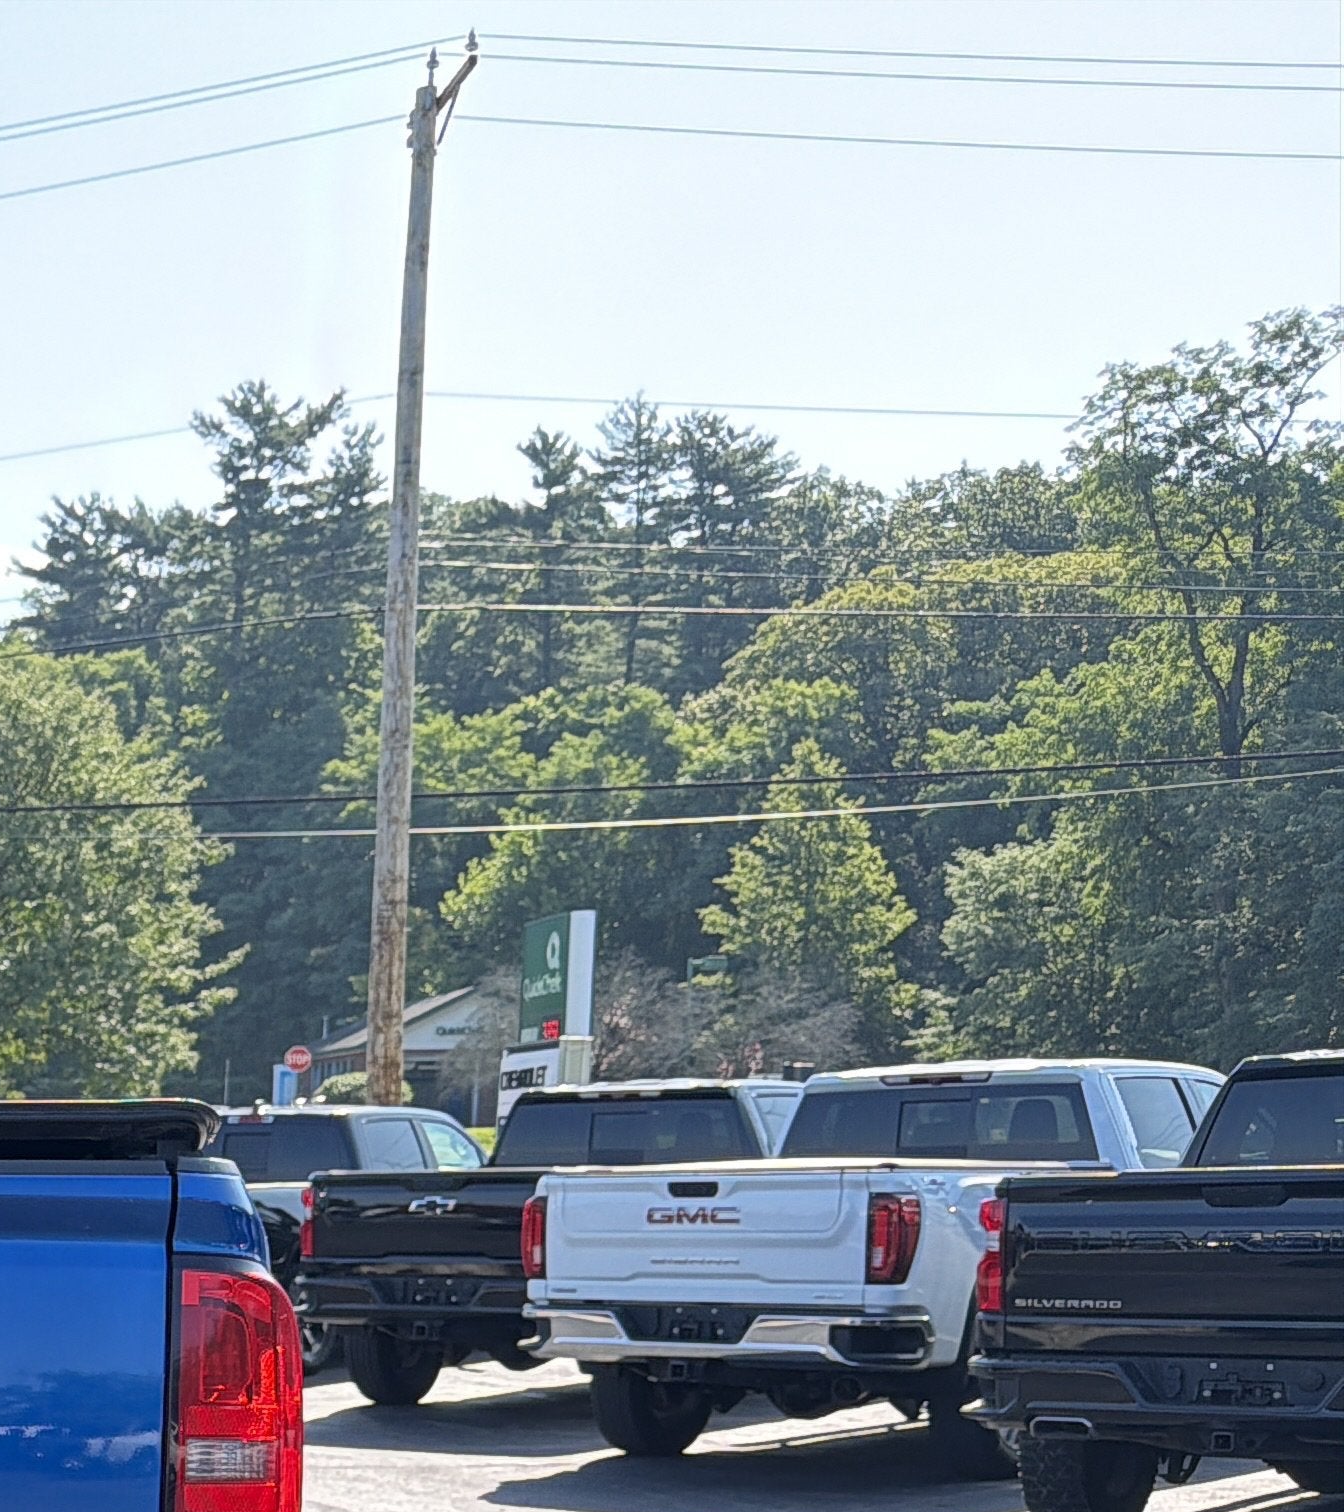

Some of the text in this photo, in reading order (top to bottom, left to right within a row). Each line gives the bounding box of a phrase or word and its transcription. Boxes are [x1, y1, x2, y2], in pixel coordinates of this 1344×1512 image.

[286, 1052, 310, 1066] STOP
[647, 1206, 741, 1224] GMC
[1014, 1298, 1122, 1309] SILVERADO
